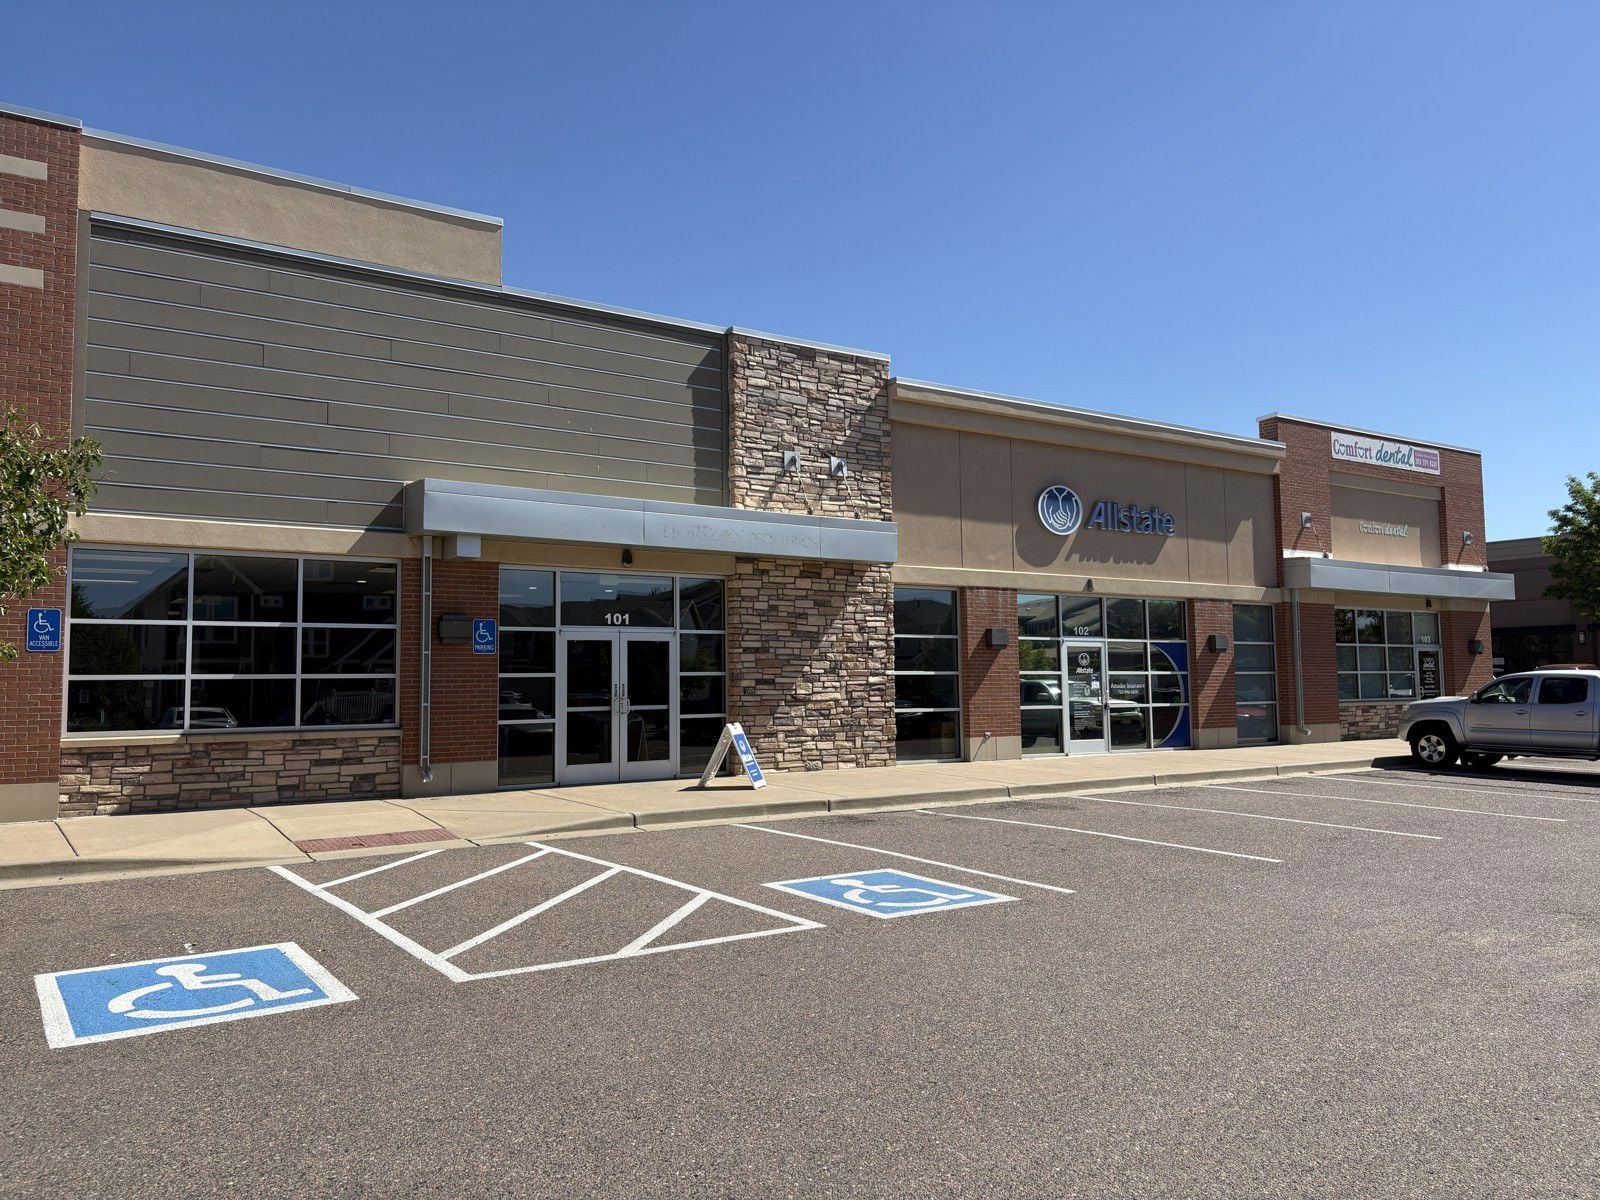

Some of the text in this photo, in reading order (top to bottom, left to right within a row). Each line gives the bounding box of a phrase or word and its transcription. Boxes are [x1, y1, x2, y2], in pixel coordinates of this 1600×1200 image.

[1333, 439, 1414, 467] Comfort dental
[1085, 500, 1176, 536] Allstate
[604, 613, 630, 625] 101
[1073, 626, 1089, 636] 102
[1421, 636, 1431, 644] 103
